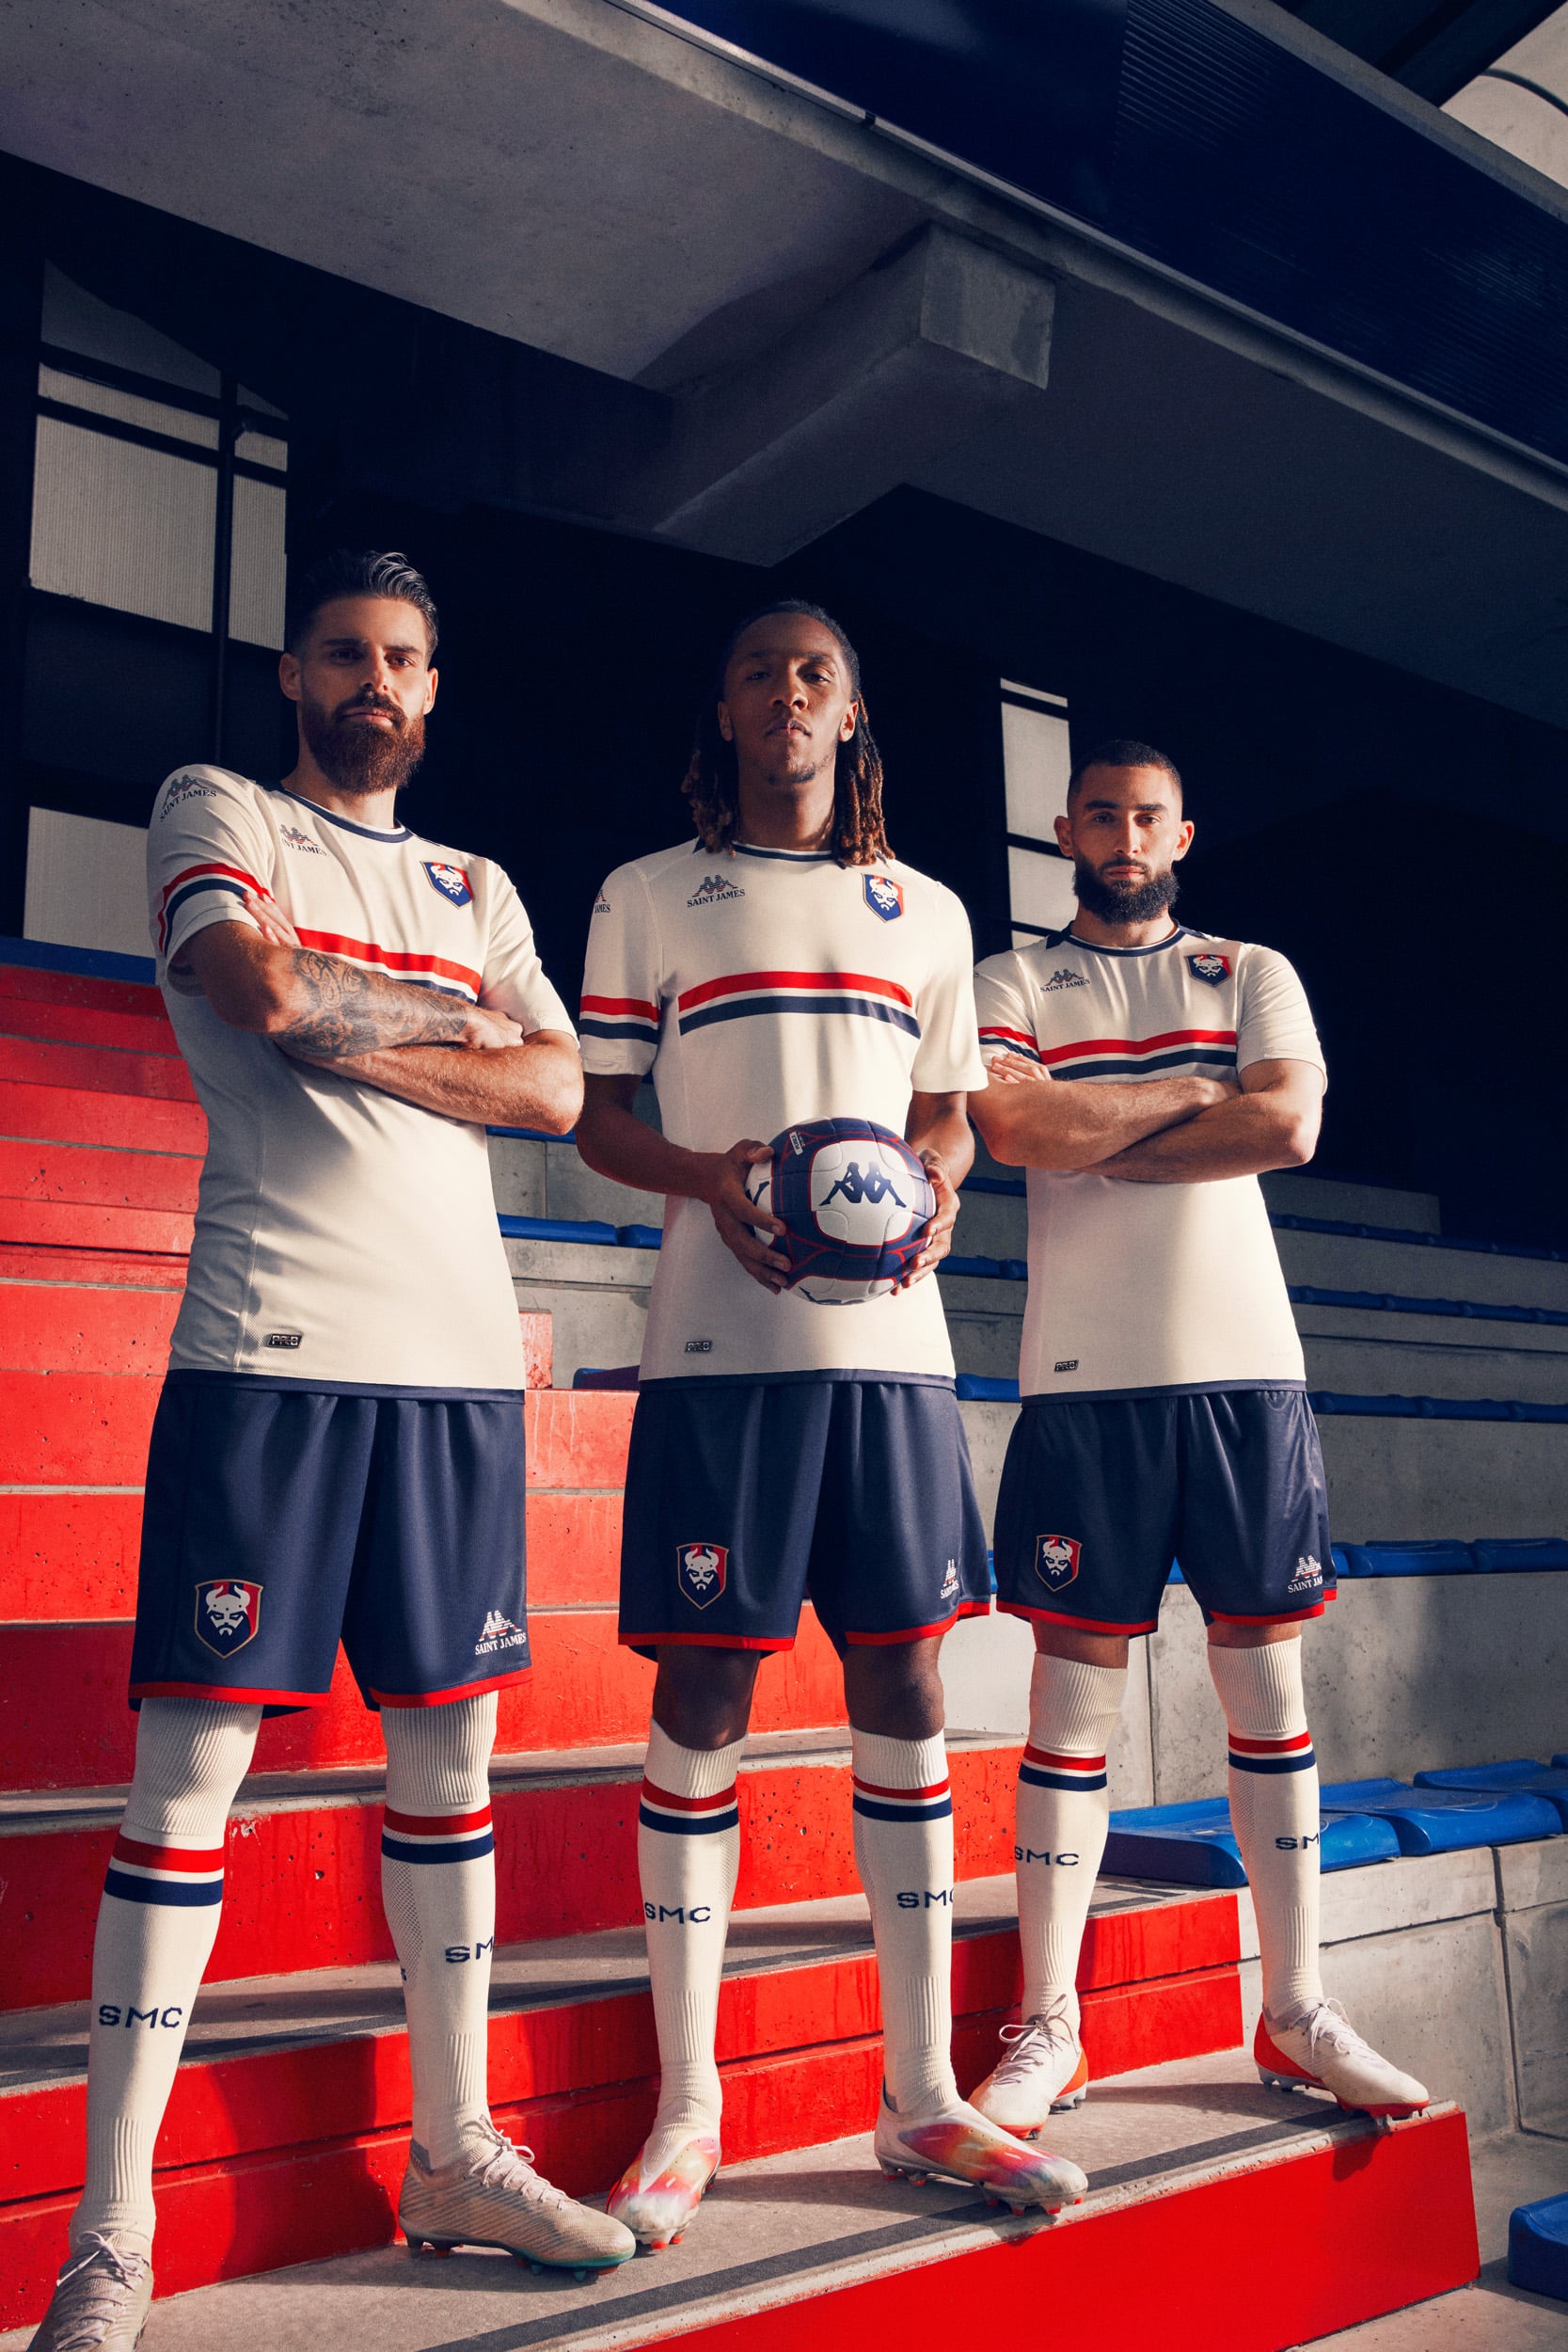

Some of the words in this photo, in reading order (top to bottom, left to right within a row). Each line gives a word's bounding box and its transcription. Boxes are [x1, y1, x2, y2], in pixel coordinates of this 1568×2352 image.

[160, 796, 180, 822] SAINT
[182, 789, 217, 801] JAMES
[687, 895, 715, 907] SAINT
[716, 888, 746, 901] JAMES
[1066, 978, 1091, 988] JAMES
[270, 1334, 300, 1346] PRO
[1288, 1580, 1313, 1593] SAINT
[475, 1640, 499, 1655] SAINT
[499, 1632, 527, 1649] JAMES
[1014, 1846, 1080, 1866] SMC
[644, 1901, 711, 1924] SMC
[99, 2004, 182, 2028] SMC
